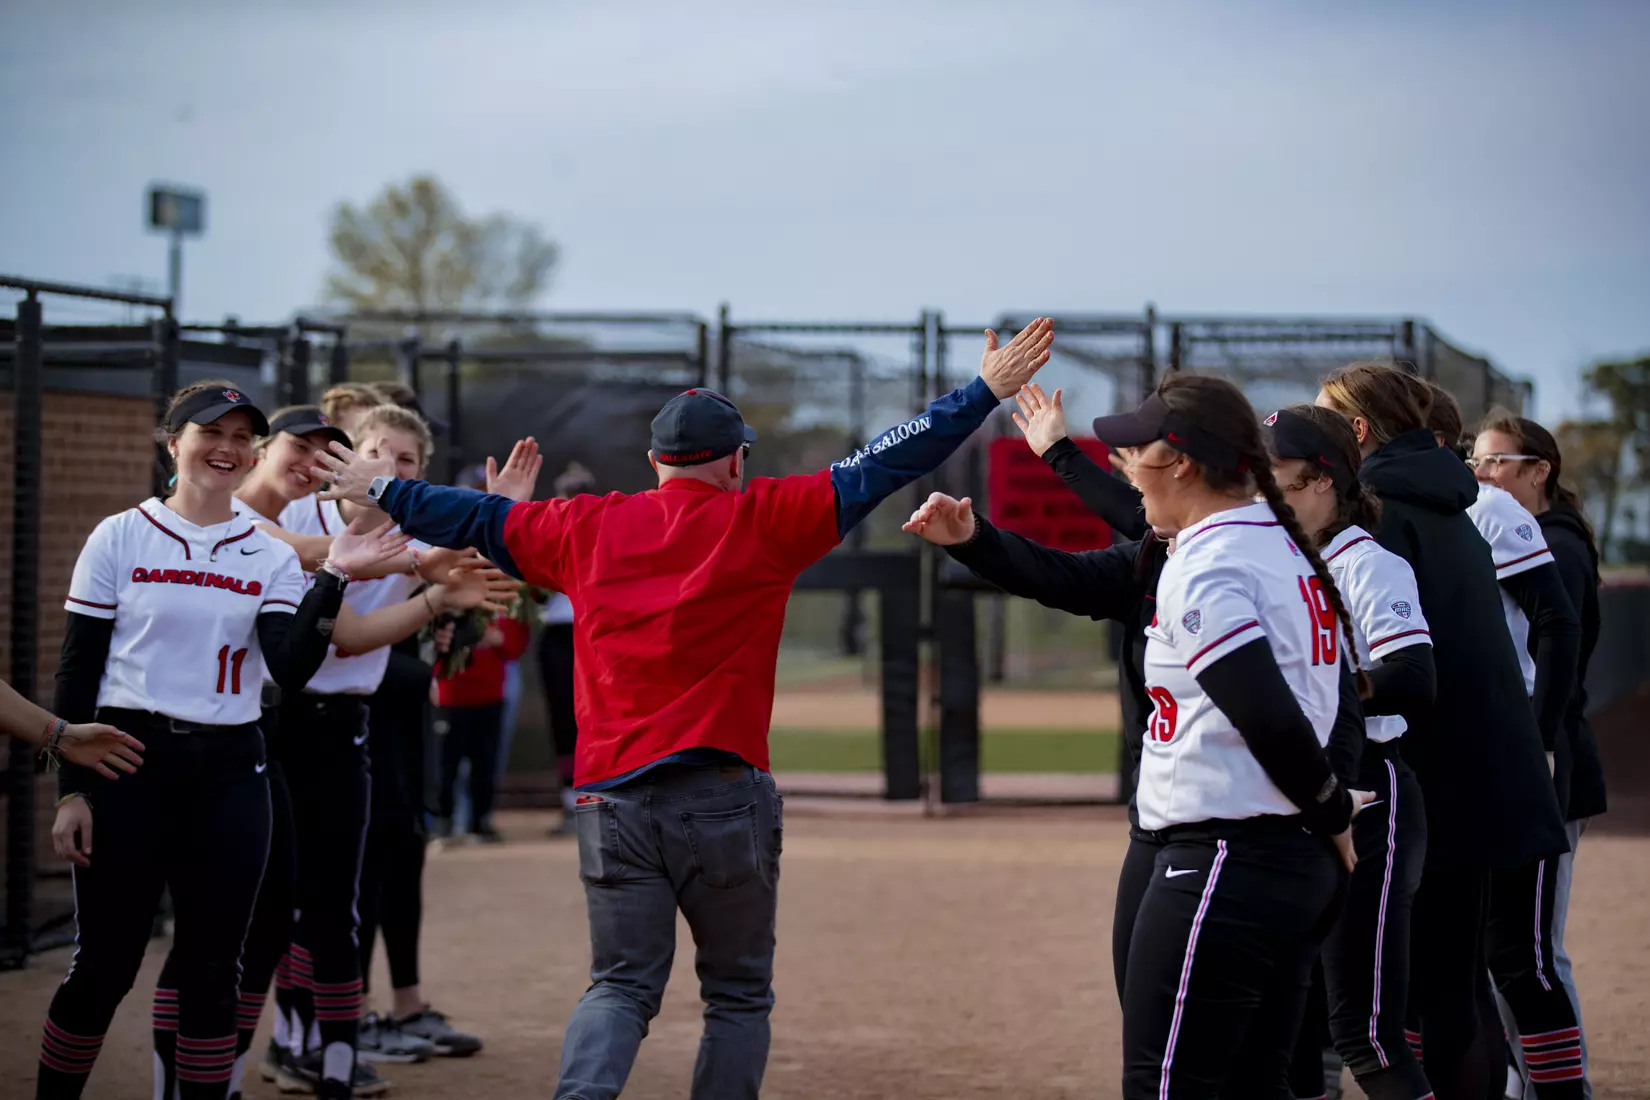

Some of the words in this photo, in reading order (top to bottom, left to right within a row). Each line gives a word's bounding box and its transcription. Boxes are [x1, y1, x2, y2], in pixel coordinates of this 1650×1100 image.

[872, 416, 931, 455] SALOON
[132, 567, 262, 596] CARDINALS
[1297, 574, 1336, 666] 19
[216, 644, 248, 694] 11
